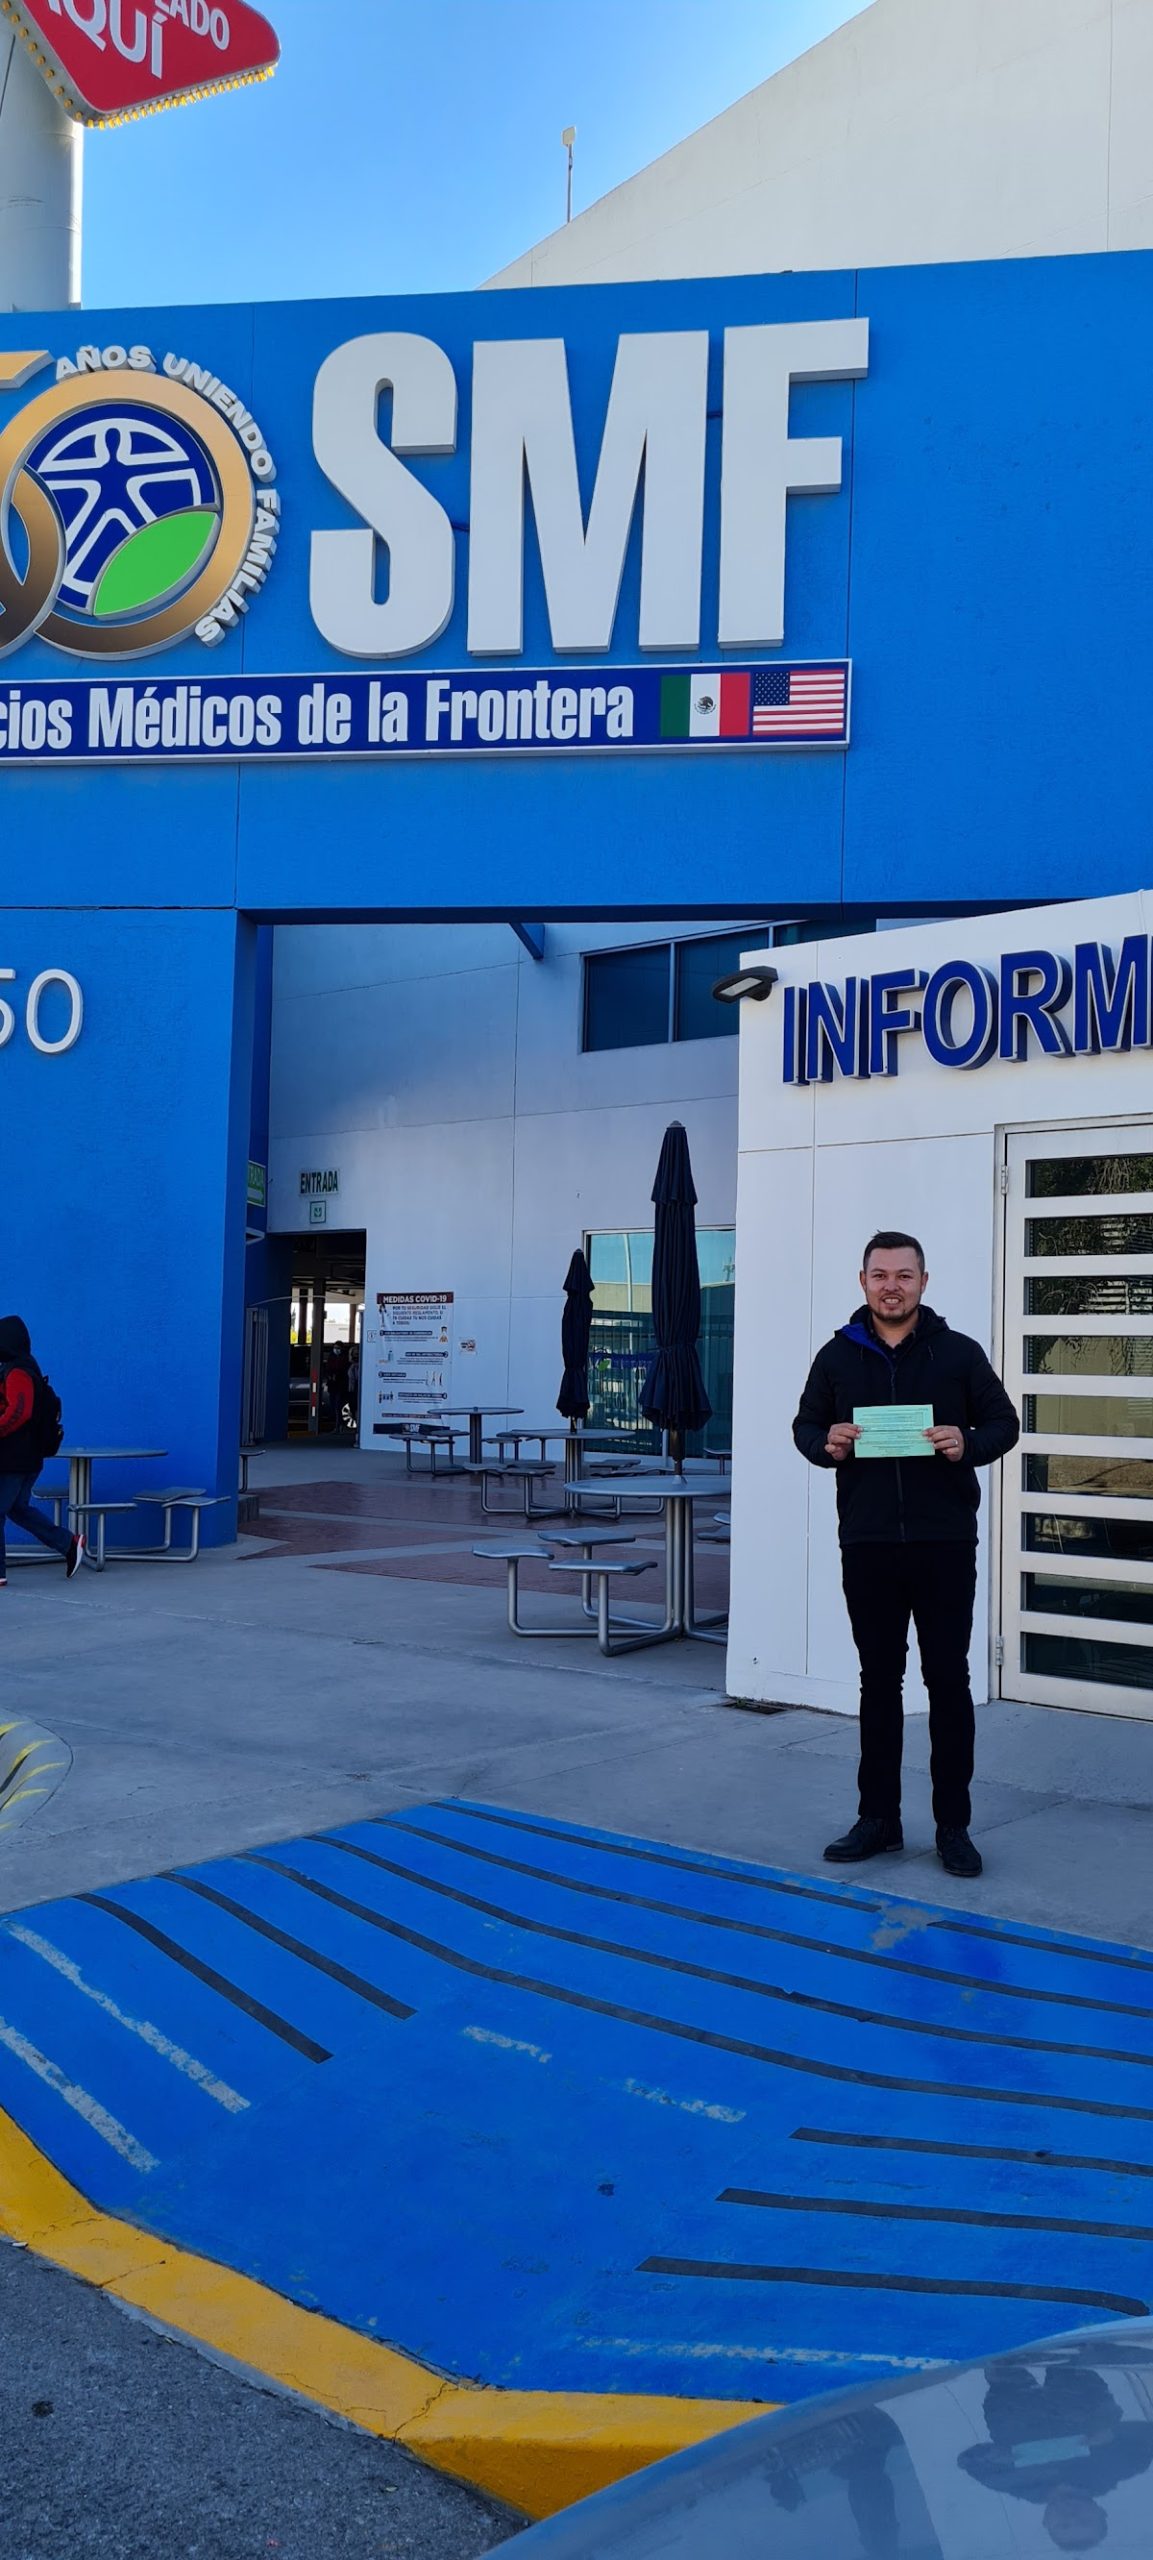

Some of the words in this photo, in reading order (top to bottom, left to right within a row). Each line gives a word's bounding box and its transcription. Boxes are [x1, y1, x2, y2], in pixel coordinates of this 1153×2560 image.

[49, 0, 168, 79] QUÍ
[154, 0, 230, 50] ADO
[56, 345, 156, 382] AÑOS
[163, 352, 277, 482] UNIENDO
[309, 317, 870, 660] SMF
[195, 489, 281, 647] FAMILIAS
[88, 685, 283, 749] Médicos
[298, 683, 352, 745] de
[368, 681, 409, 744] la
[425, 679, 634, 742] Frontera
[783, 934, 1153, 1086] INFORM
[300, 1170, 338, 1194] ENTRADA
